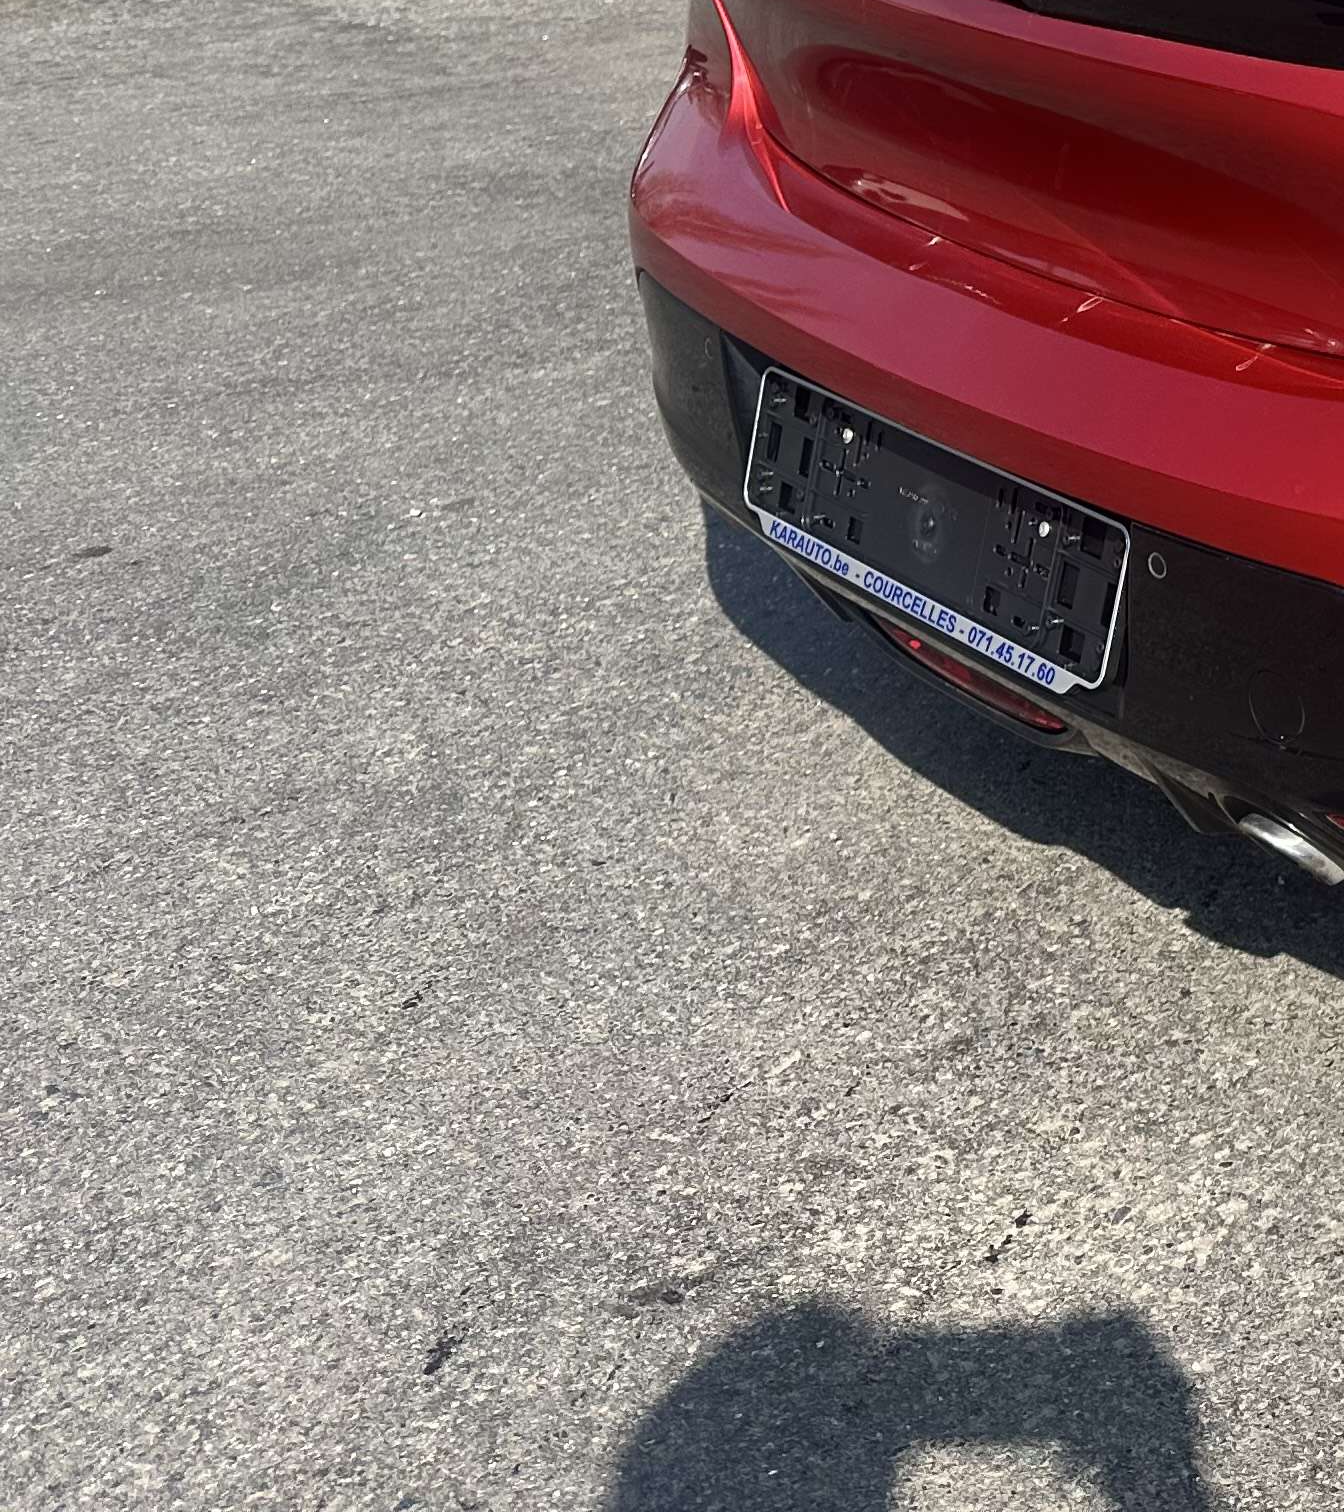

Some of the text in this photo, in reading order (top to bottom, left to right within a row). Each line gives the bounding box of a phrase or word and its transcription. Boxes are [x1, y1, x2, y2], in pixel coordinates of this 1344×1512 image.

[769, 520, 850, 577] KARAUTO.be
[863, 571, 957, 633] COURCELLES
[967, 626, 1056, 686] 071.45.17.60
